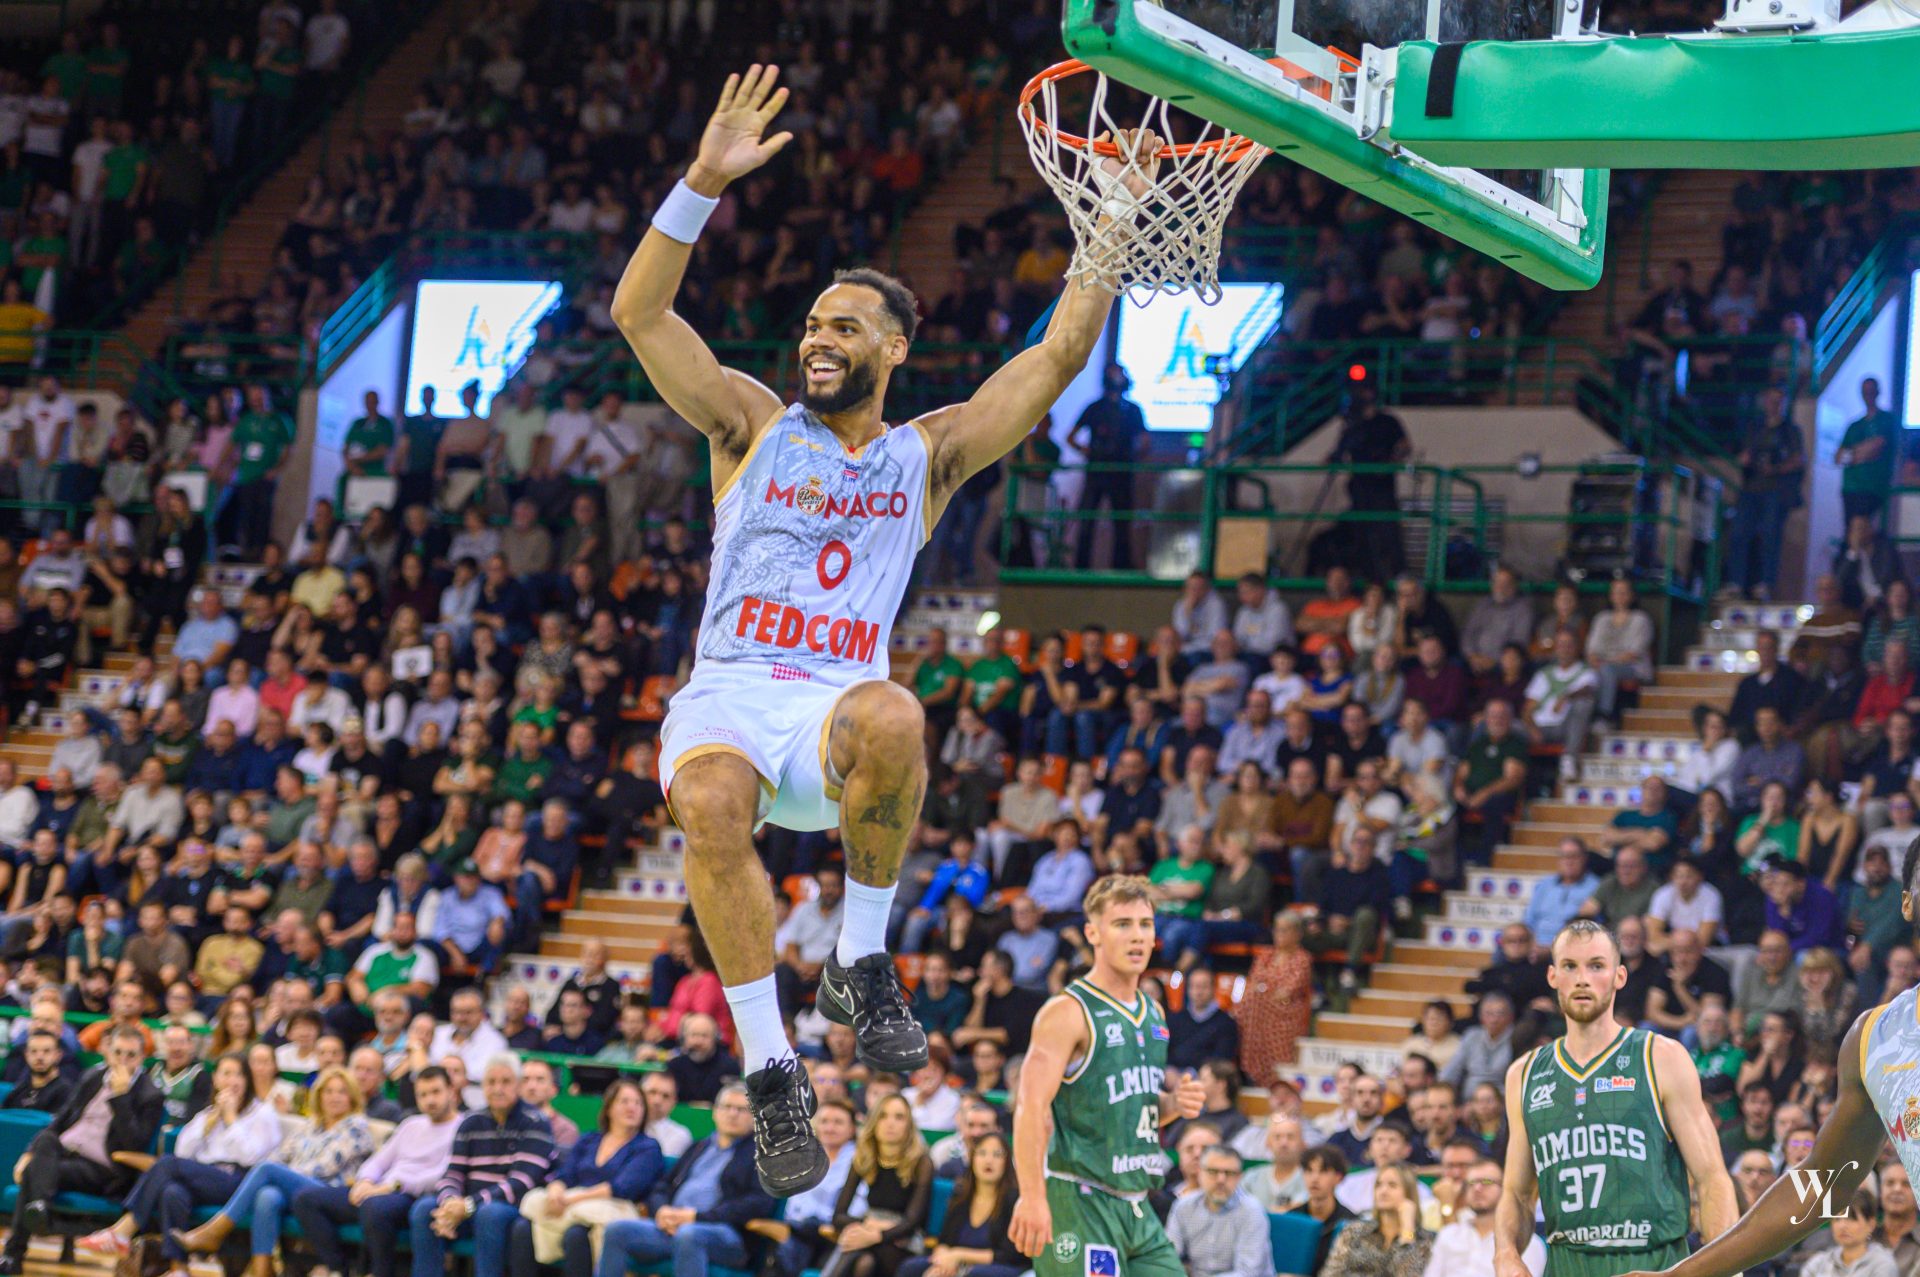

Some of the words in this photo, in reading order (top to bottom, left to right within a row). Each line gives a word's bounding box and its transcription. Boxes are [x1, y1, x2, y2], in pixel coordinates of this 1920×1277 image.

[816, 540, 852, 590] 0
[735, 596, 880, 664] FEDCOM
[1595, 1076, 1635, 1091] BigMat
[1533, 1123, 1647, 1176] LIMOGES
[1558, 1163, 1607, 1213] 37
